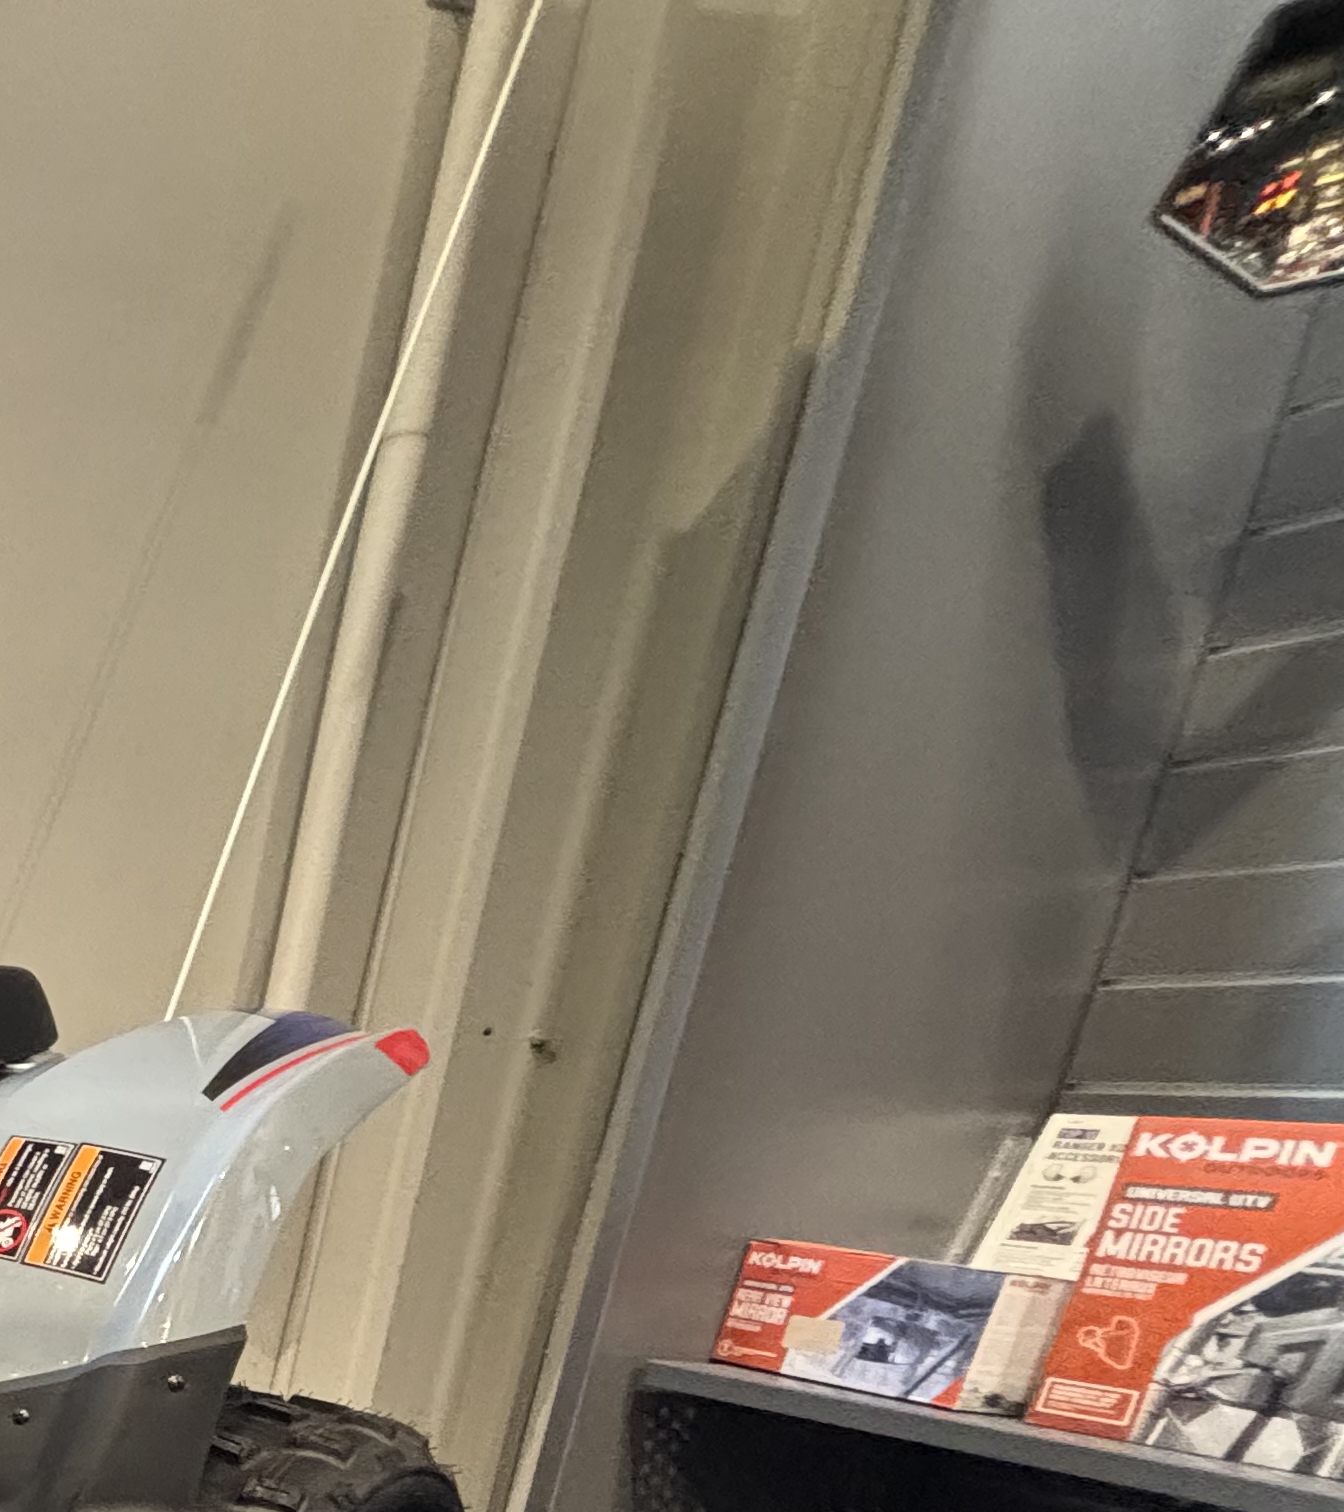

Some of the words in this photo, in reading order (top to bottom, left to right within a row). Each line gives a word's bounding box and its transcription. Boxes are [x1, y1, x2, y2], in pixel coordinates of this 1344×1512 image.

[1134, 1131, 1339, 1168] KOLPIN
[51, 1170, 82, 1225] WARNING
[1107, 1202, 1188, 1234] SIDE
[748, 1251, 826, 1274] KOLPIN
[1095, 1229, 1269, 1273] MIRRORS
